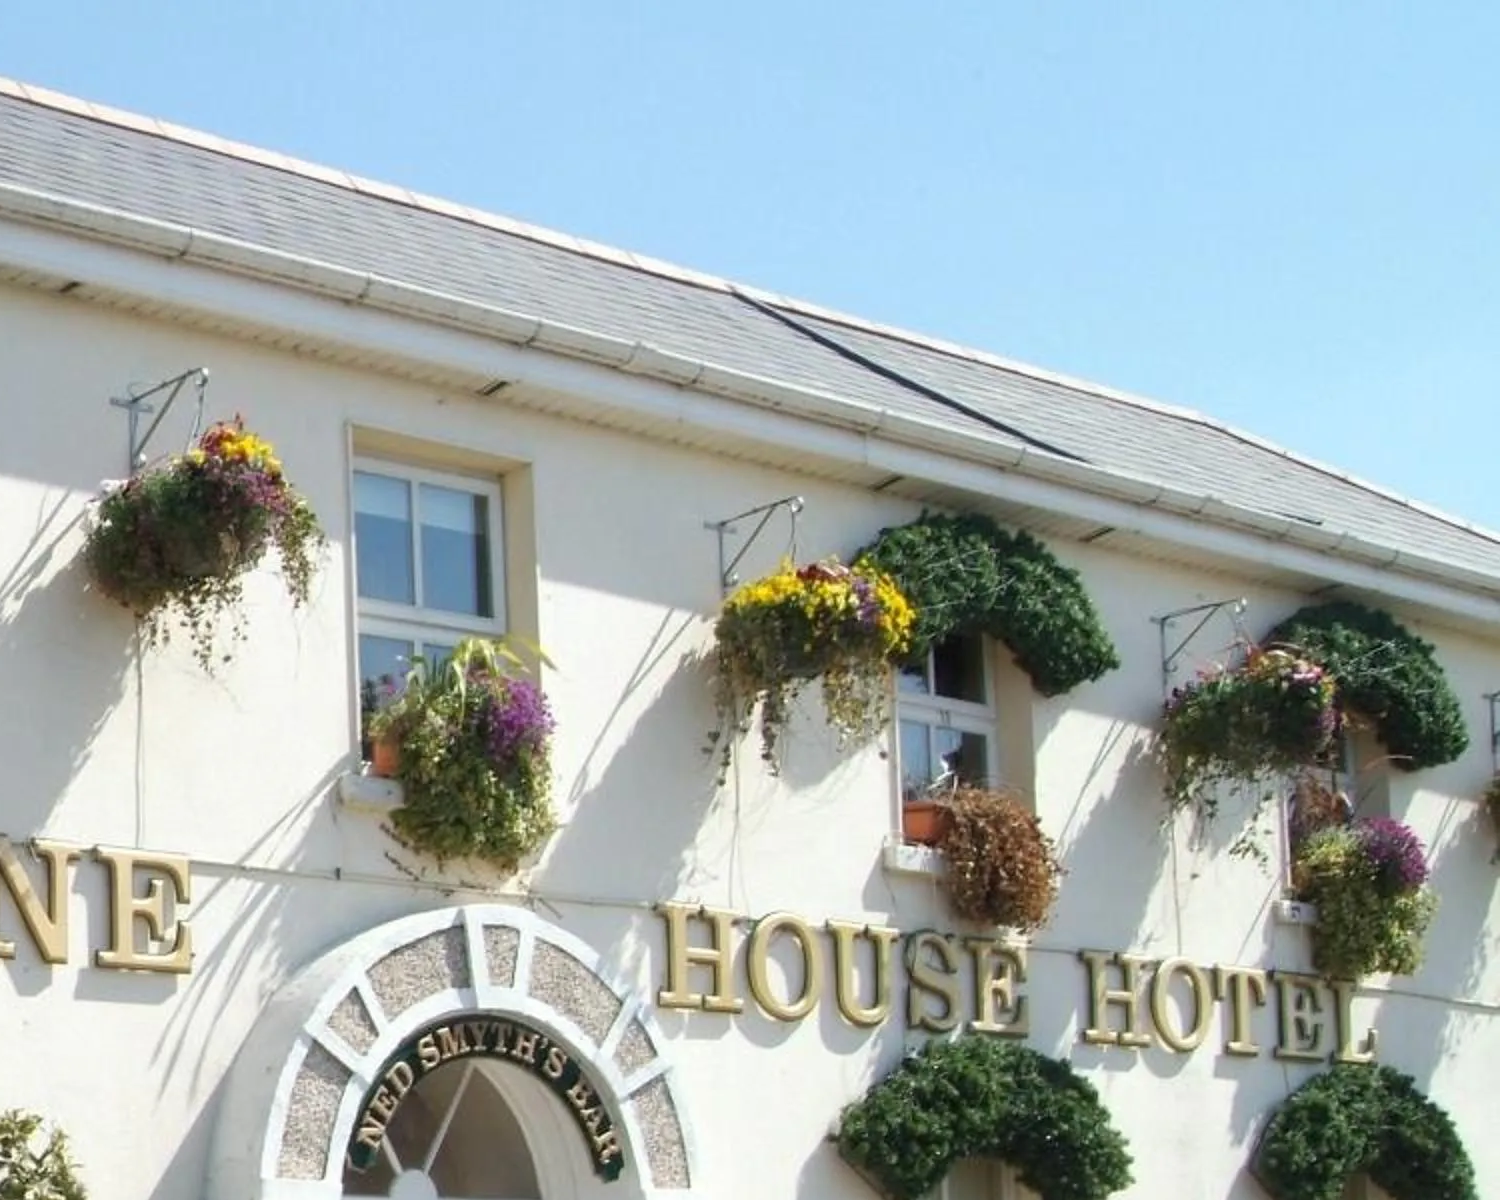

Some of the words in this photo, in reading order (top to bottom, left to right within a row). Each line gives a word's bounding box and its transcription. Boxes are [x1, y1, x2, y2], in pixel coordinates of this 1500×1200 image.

[657, 899, 1031, 1039] HOUSE
[1078, 948, 1379, 1063] HOTEL
[356, 1061, 414, 1151] NED
[418, 1021, 568, 1078] SMYTH'S
[566, 1083, 622, 1164] BAR
